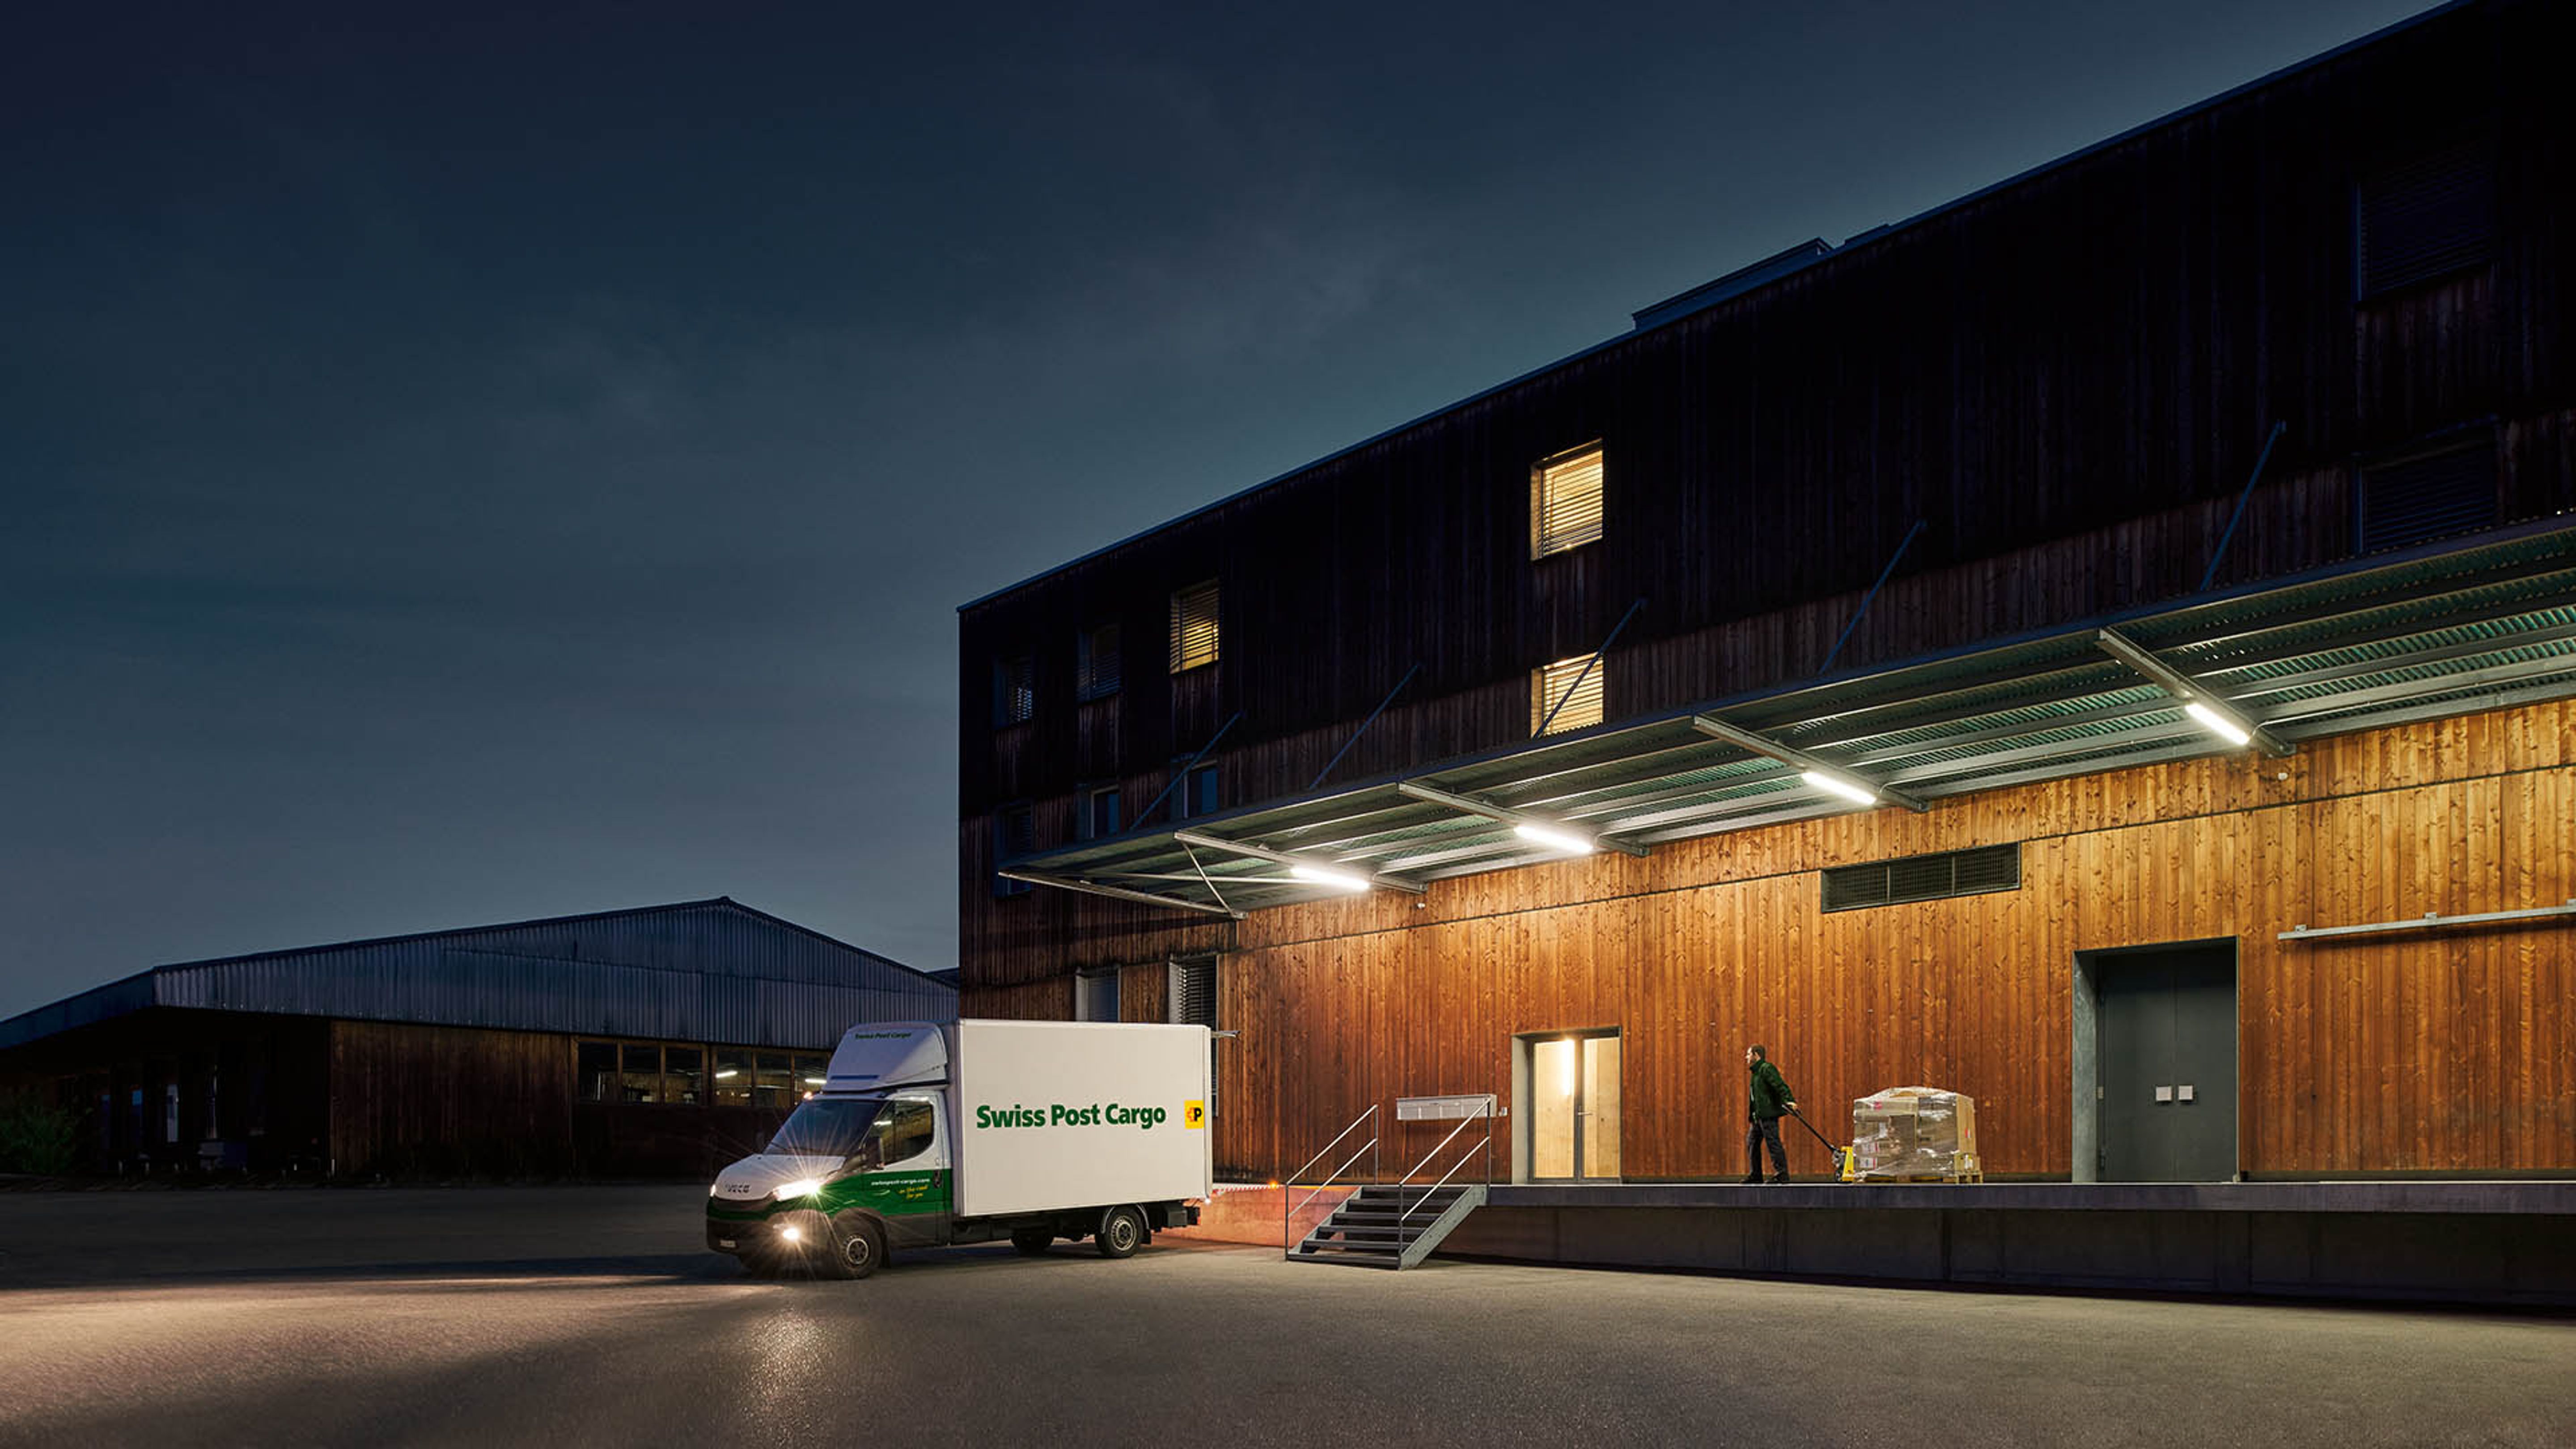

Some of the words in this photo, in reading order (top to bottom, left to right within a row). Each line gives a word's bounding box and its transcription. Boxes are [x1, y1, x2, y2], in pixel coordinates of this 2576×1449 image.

[977, 1104, 1046, 1128] Swiss
[1051, 1104, 1101, 1126] Post
[1106, 1104, 1166, 1129] Cargo
[1194, 1107, 1202, 1121] P
